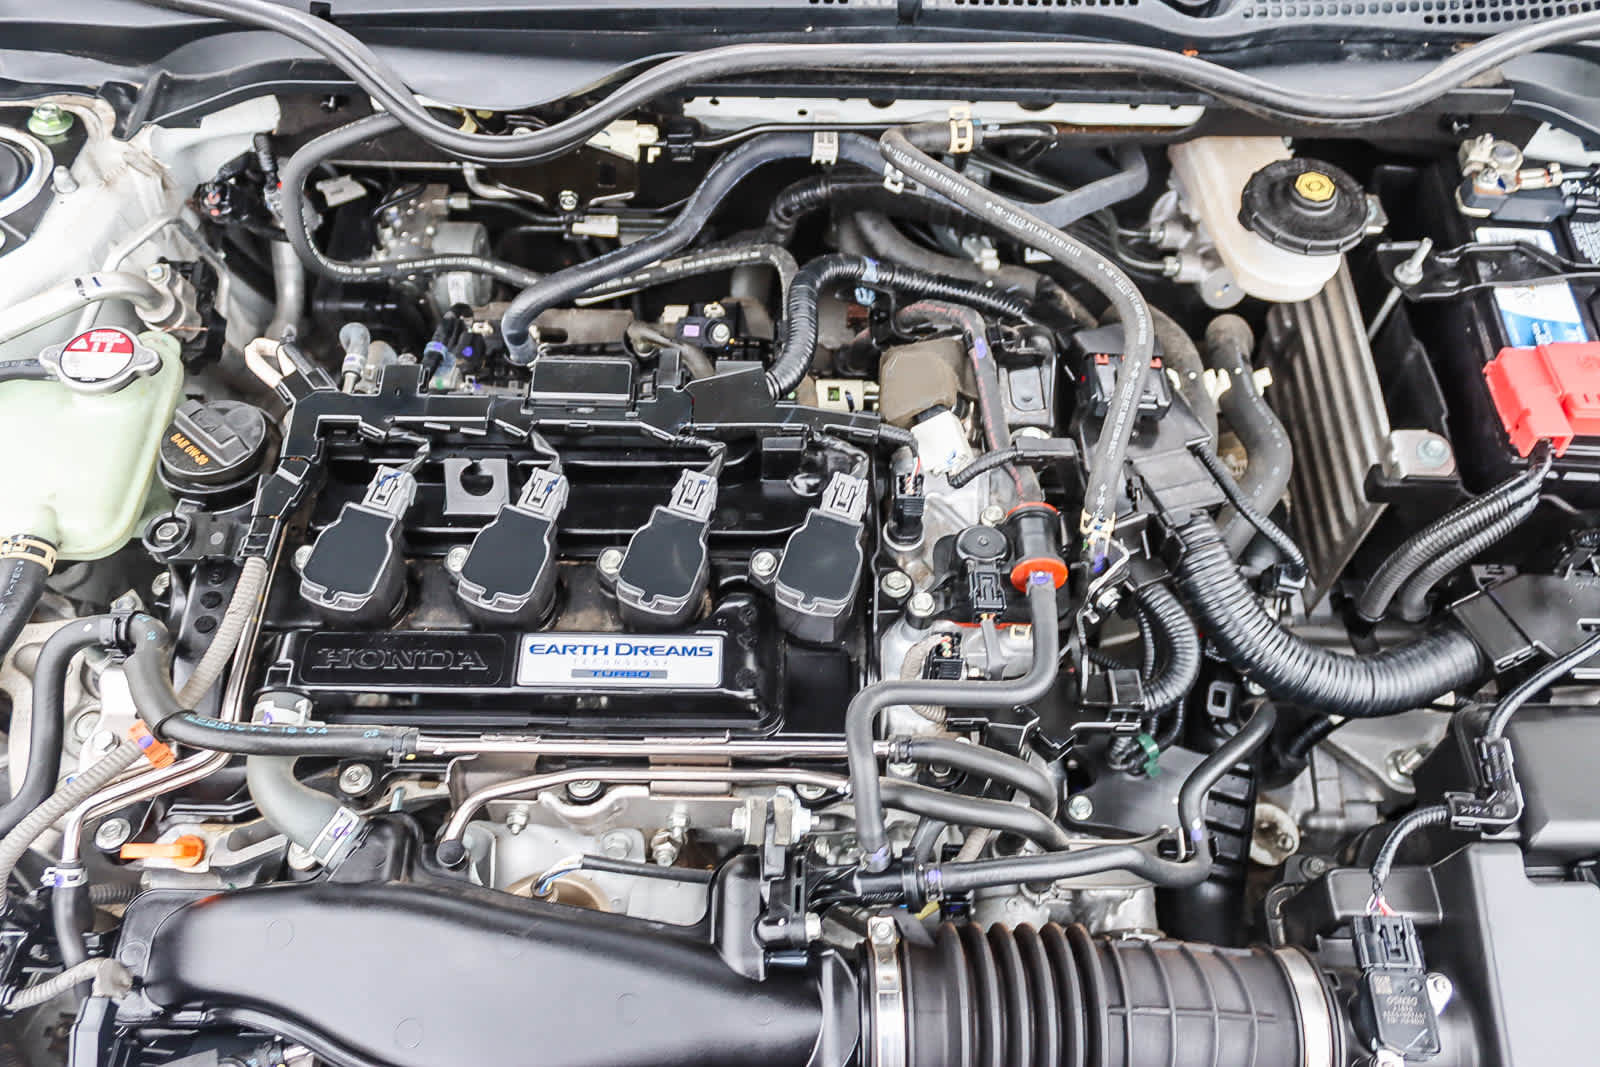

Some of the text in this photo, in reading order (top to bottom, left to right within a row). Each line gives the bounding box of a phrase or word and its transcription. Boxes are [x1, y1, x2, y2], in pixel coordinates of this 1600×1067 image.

[529, 642, 713, 657] EARTH DREAMS
[312, 648, 488, 671] HONDA
[591, 669, 651, 679] TURBO
